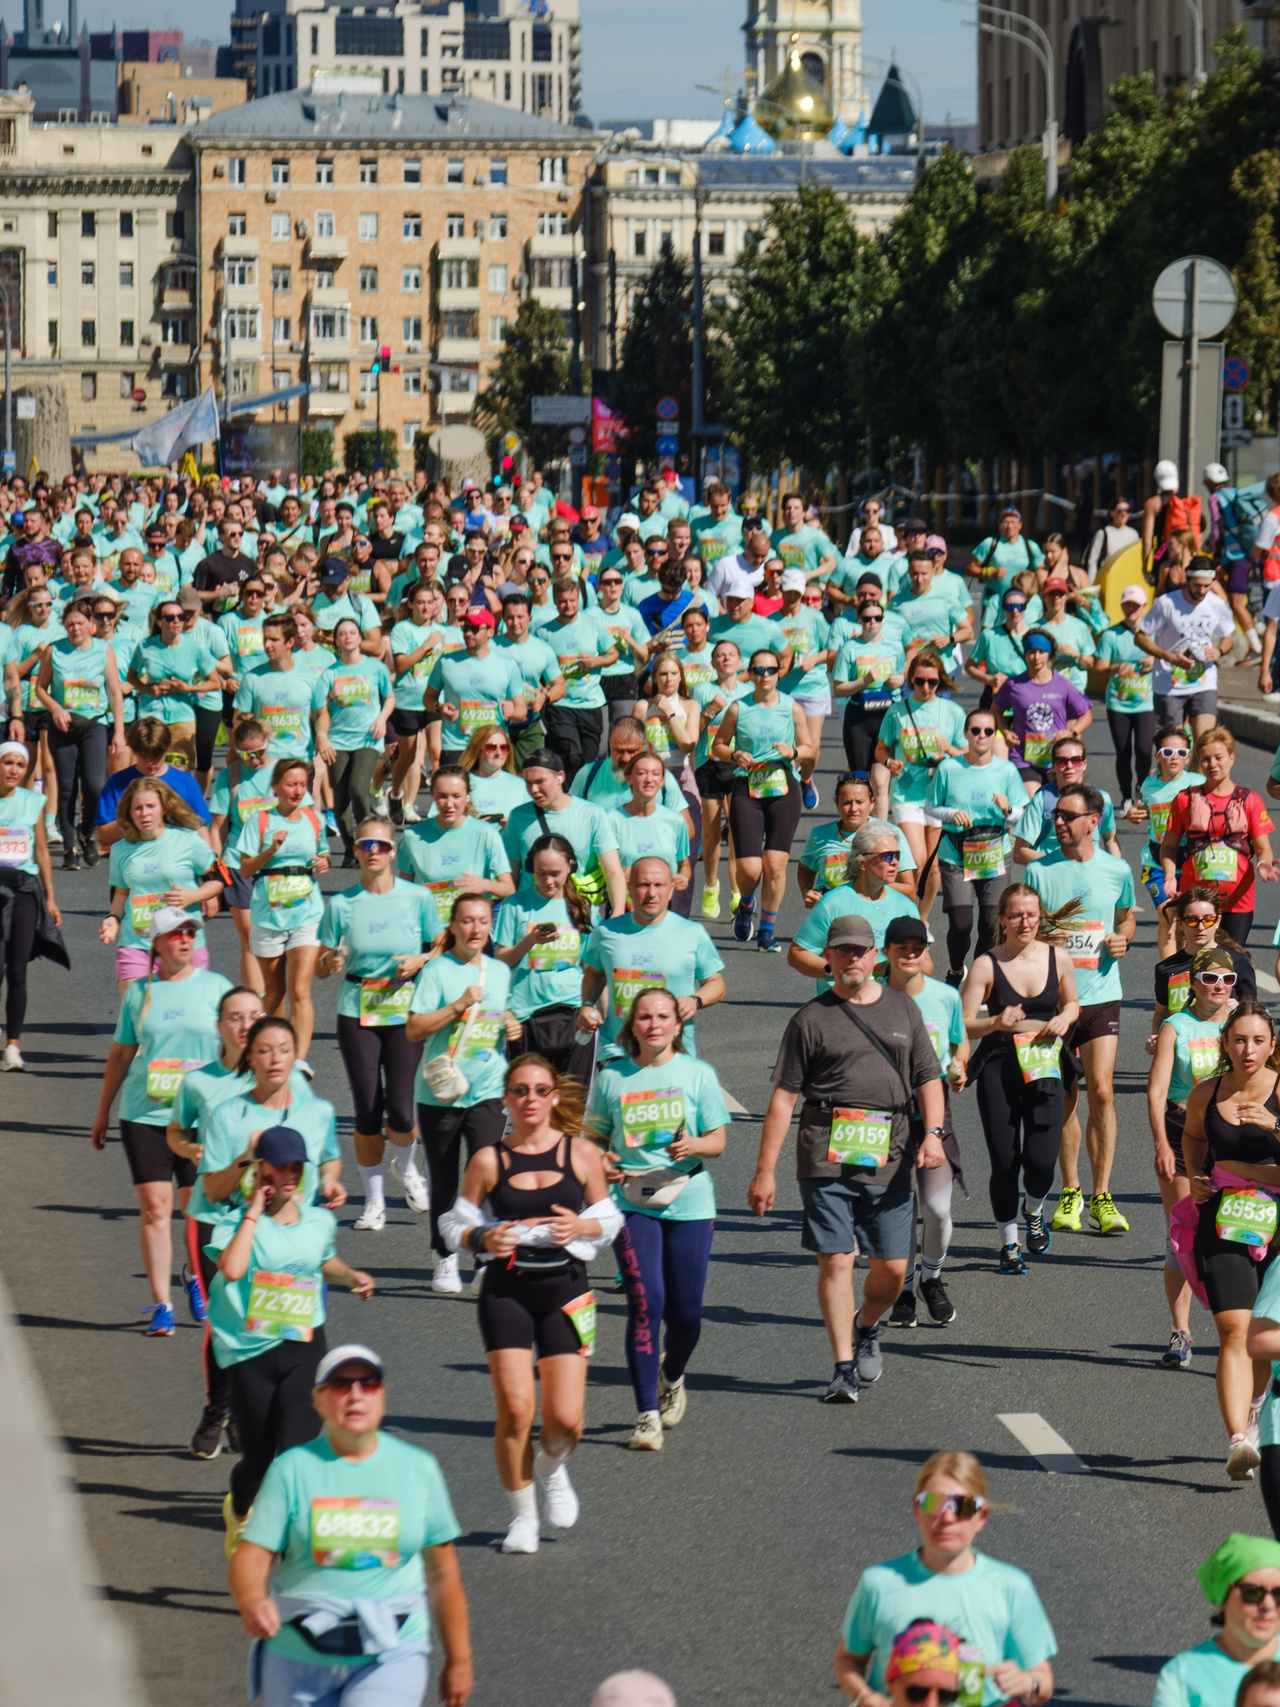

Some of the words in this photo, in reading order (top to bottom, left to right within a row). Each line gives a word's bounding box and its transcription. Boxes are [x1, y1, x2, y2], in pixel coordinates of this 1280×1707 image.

[685, 671, 713, 682] 4947
[859, 664, 891, 675] 7013
[342, 682, 370, 694] 8913
[462, 709, 495, 720] 69203
[0, 841, 28, 854] 373
[966, 849, 1003, 865] 70753
[363, 989, 412, 1006] 70469
[625, 1100, 683, 1124] 65810
[833, 1122, 888, 1146] 69159
[1221, 1197, 1277, 1224] 65539
[253, 1286, 314, 1316] 72926
[629, 1282, 653, 1356] SPORT
[316, 1512, 398, 1539] 68832
